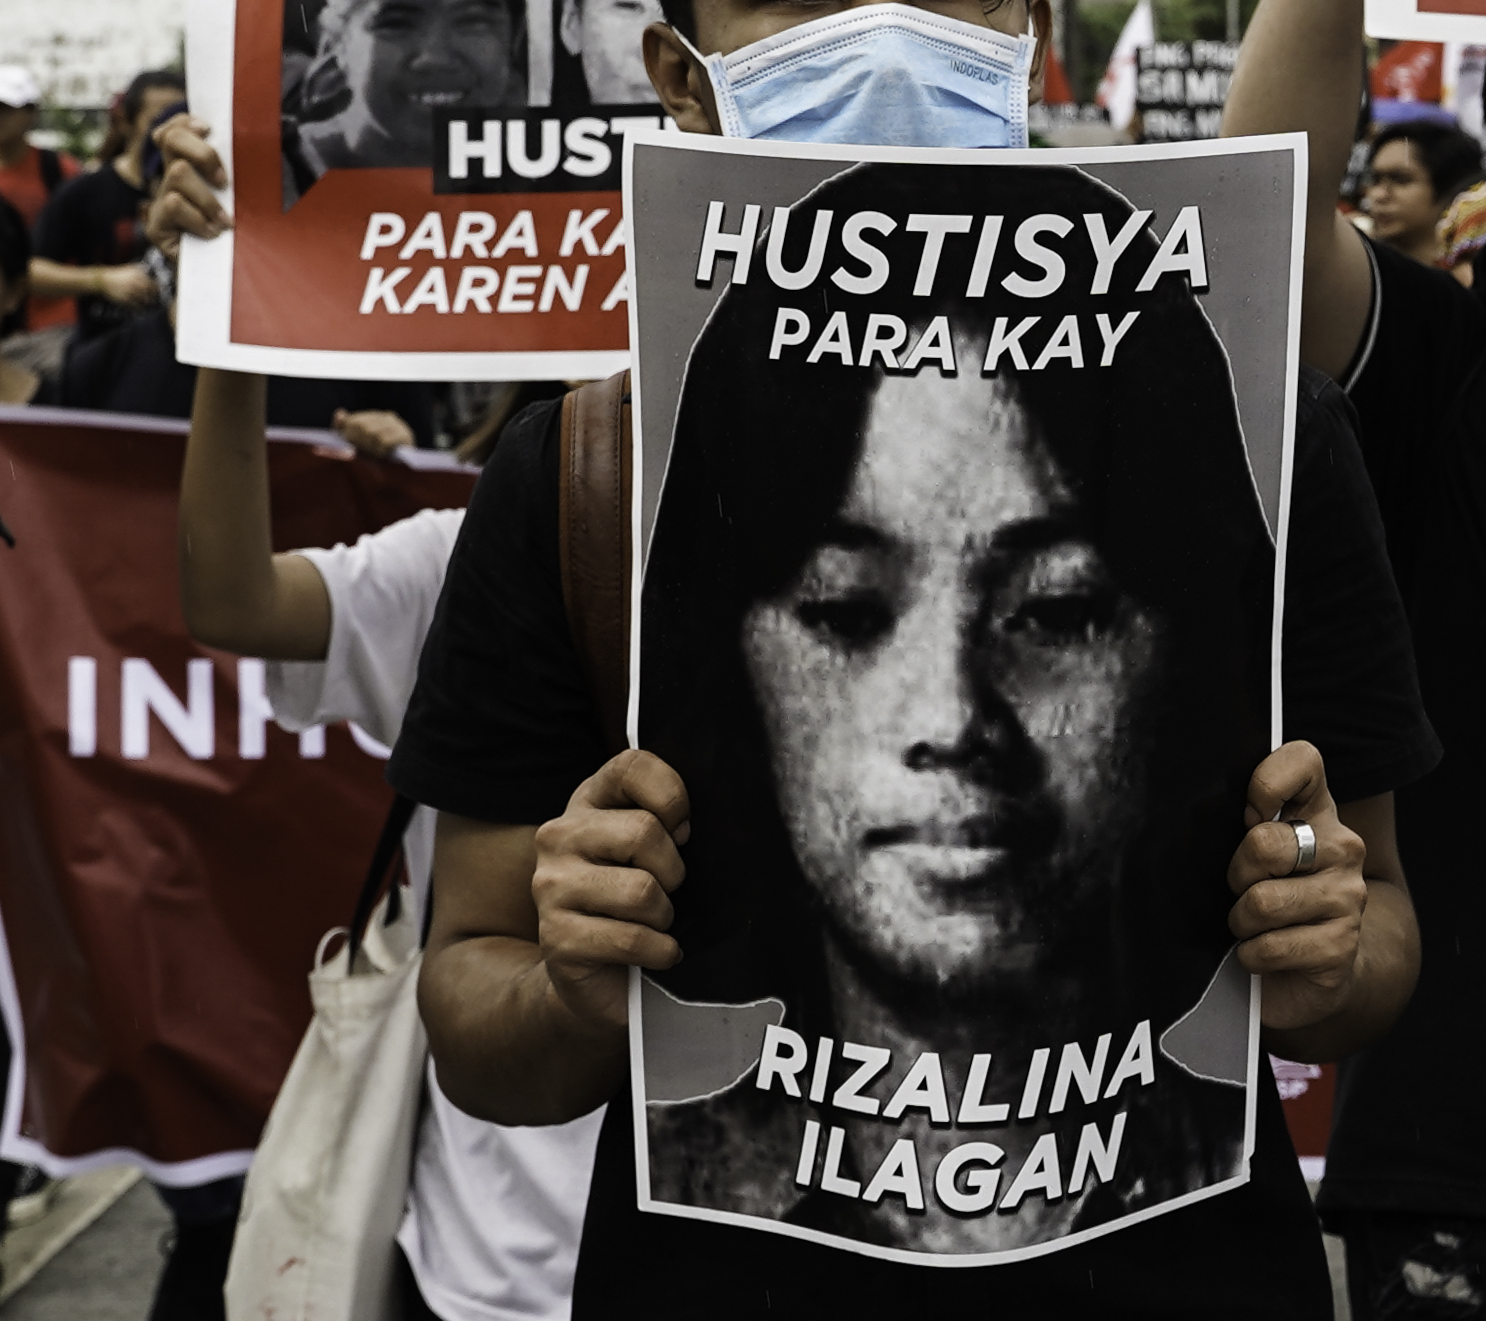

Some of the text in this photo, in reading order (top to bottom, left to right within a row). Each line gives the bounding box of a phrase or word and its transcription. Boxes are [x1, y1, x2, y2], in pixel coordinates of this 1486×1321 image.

[950, 59, 999, 86] INDOPLAS
[360, 209, 539, 260] PARA
[695, 201, 1209, 298] HUSTISYA
[360, 264, 590, 314] KAREN
[769, 307, 1141, 372] PARA KAY
[755, 1019, 1156, 1124] RIZALINA
[795, 1111, 1128, 1214] ILAGAN
